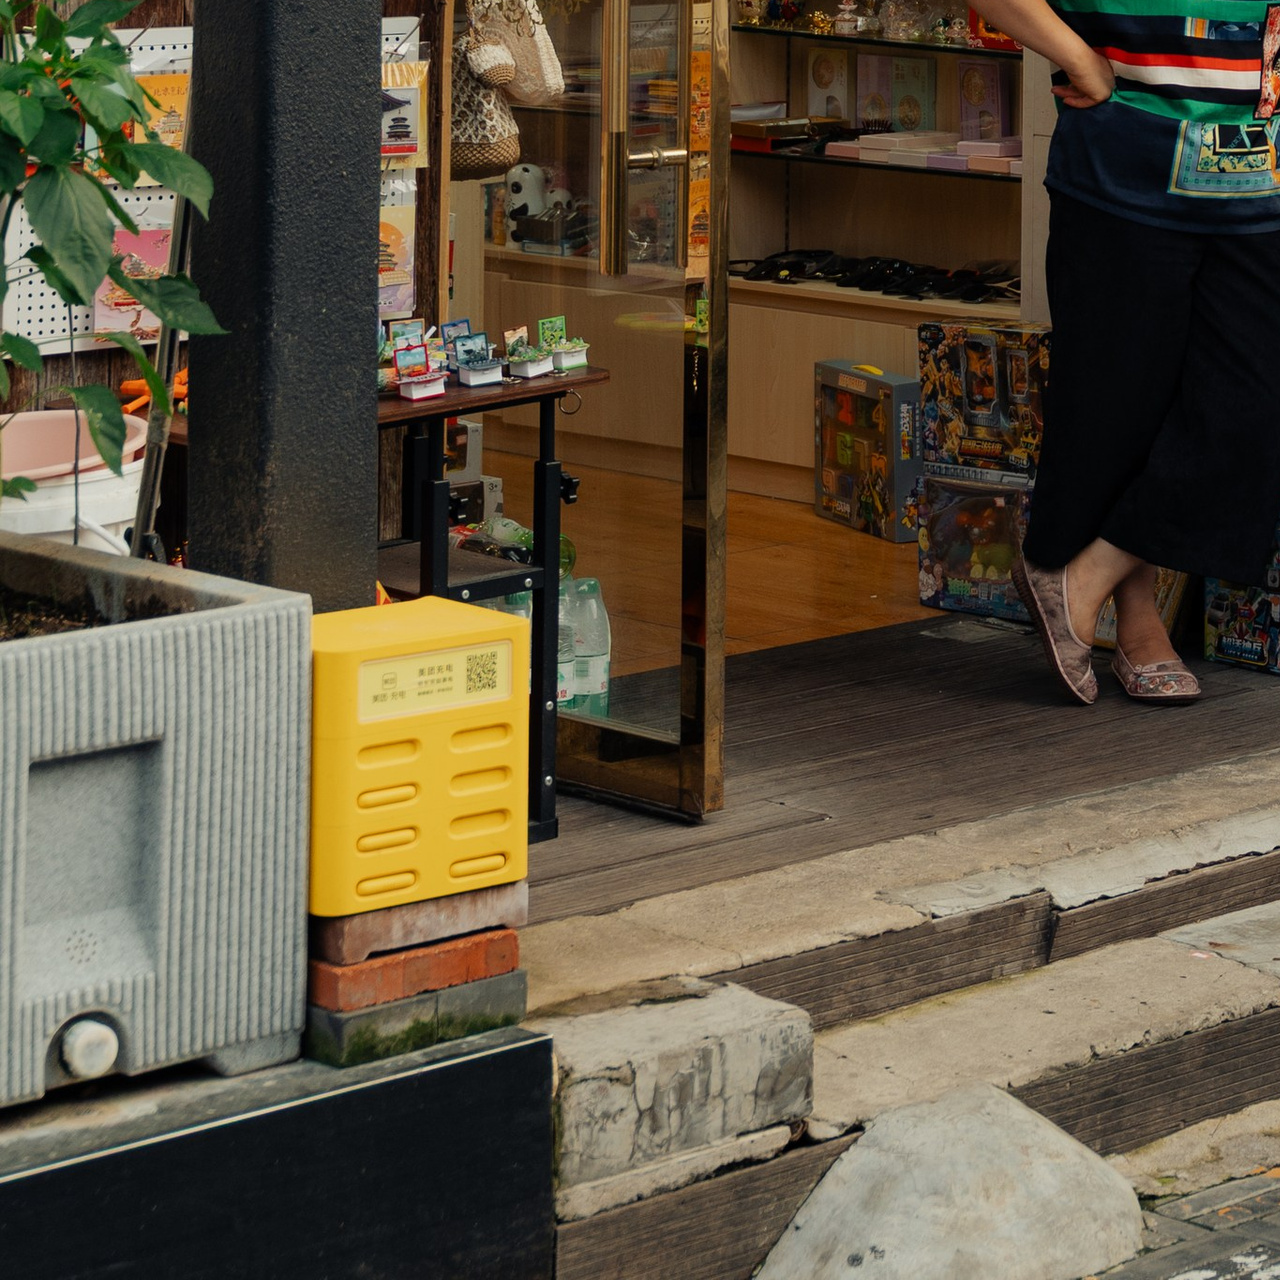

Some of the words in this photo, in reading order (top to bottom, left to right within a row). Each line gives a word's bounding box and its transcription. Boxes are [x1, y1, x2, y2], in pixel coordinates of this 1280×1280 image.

[489, 482, 498, 491] 3+
[418, 663, 454, 677] 美团充电
